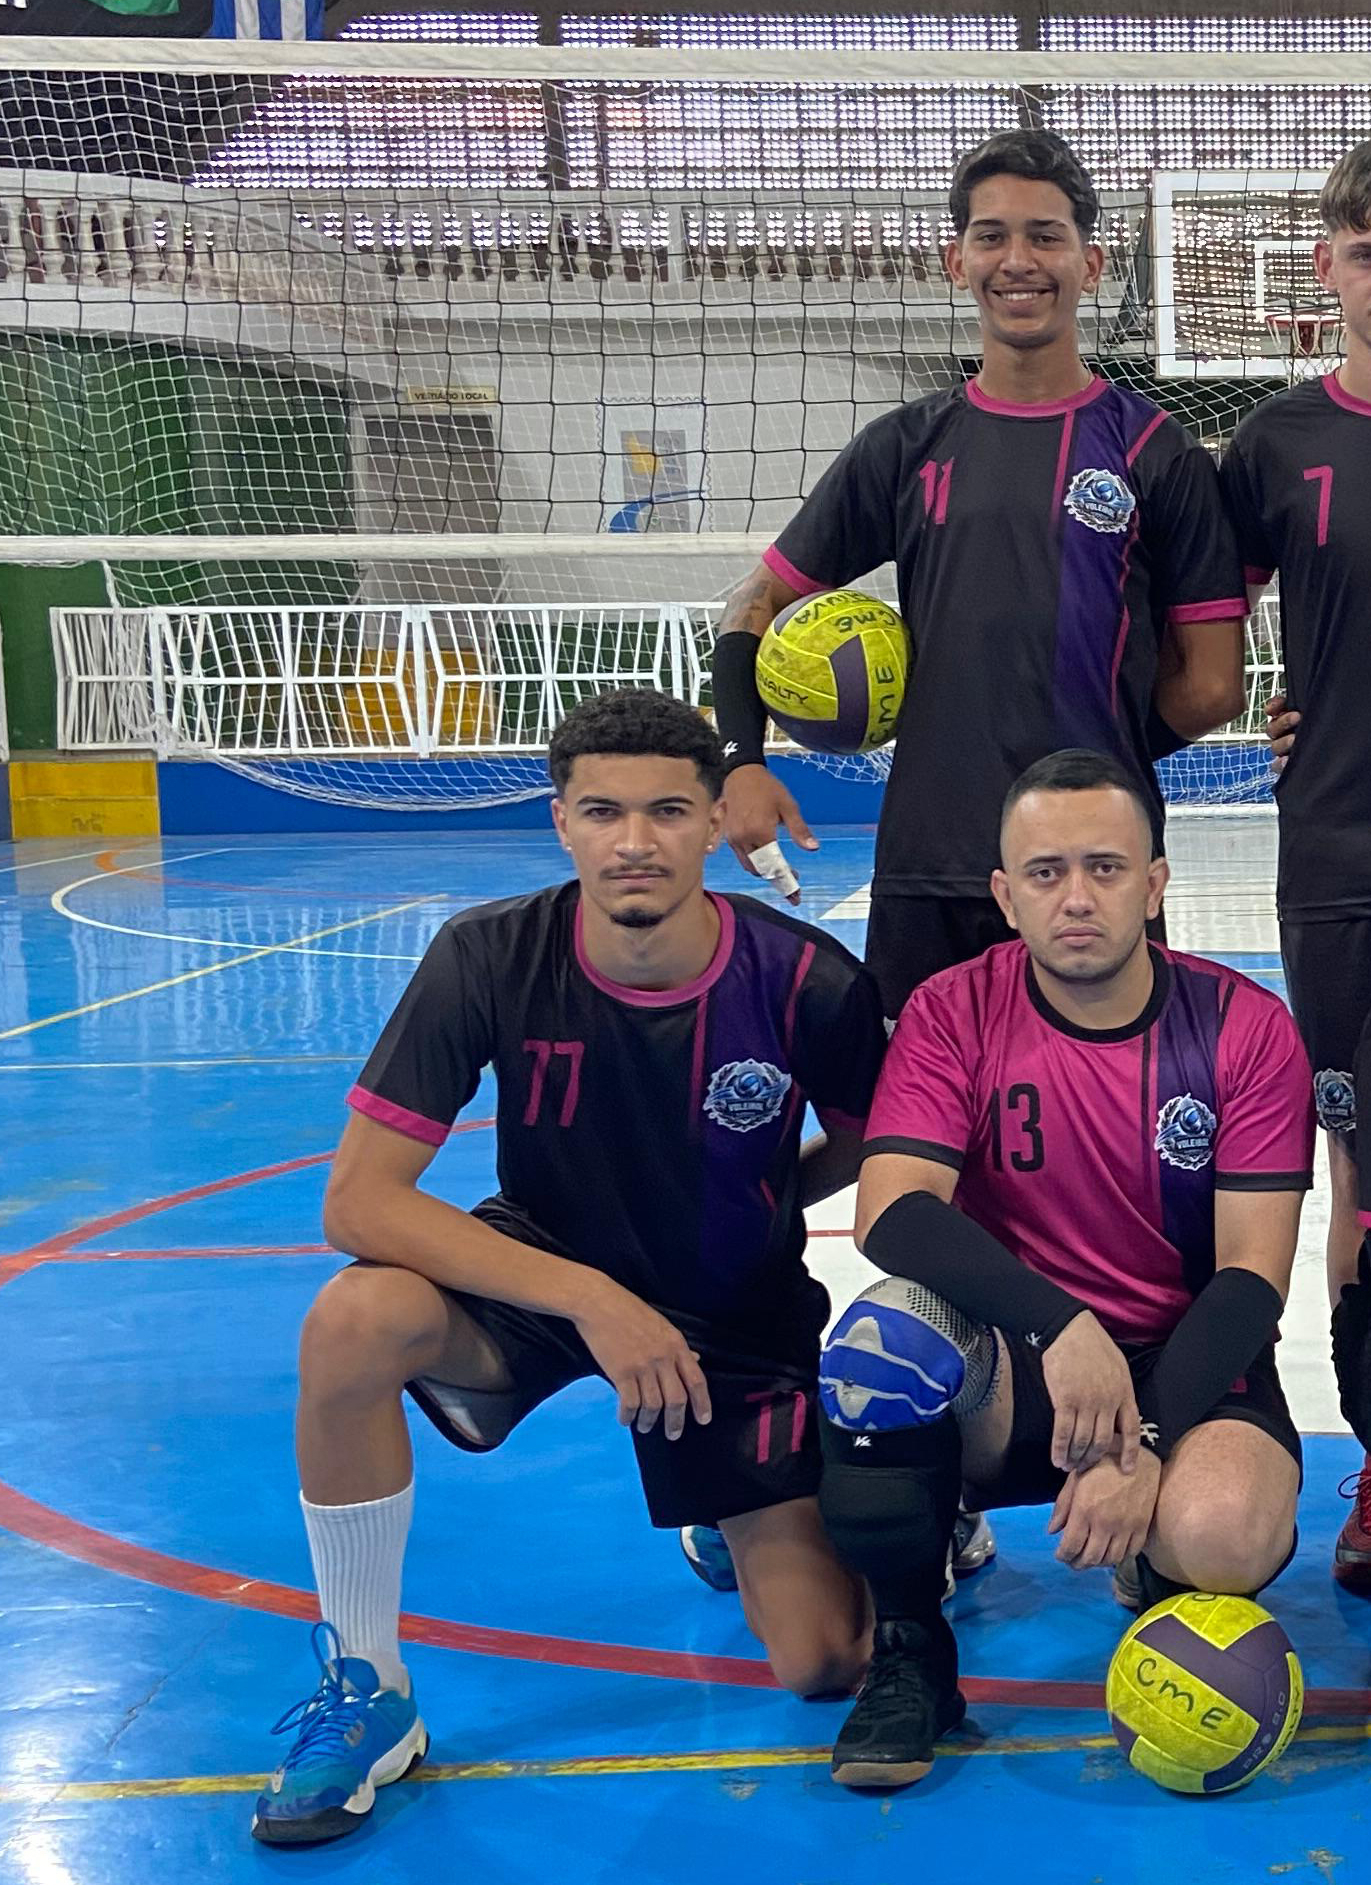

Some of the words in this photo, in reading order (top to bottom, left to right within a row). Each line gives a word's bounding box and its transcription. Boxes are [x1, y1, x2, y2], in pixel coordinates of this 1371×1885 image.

[919, 457, 955, 525] 11
[1303, 465, 1333, 547] 7
[523, 1039, 585, 1128] 77
[990, 1083, 1045, 1172] 13
